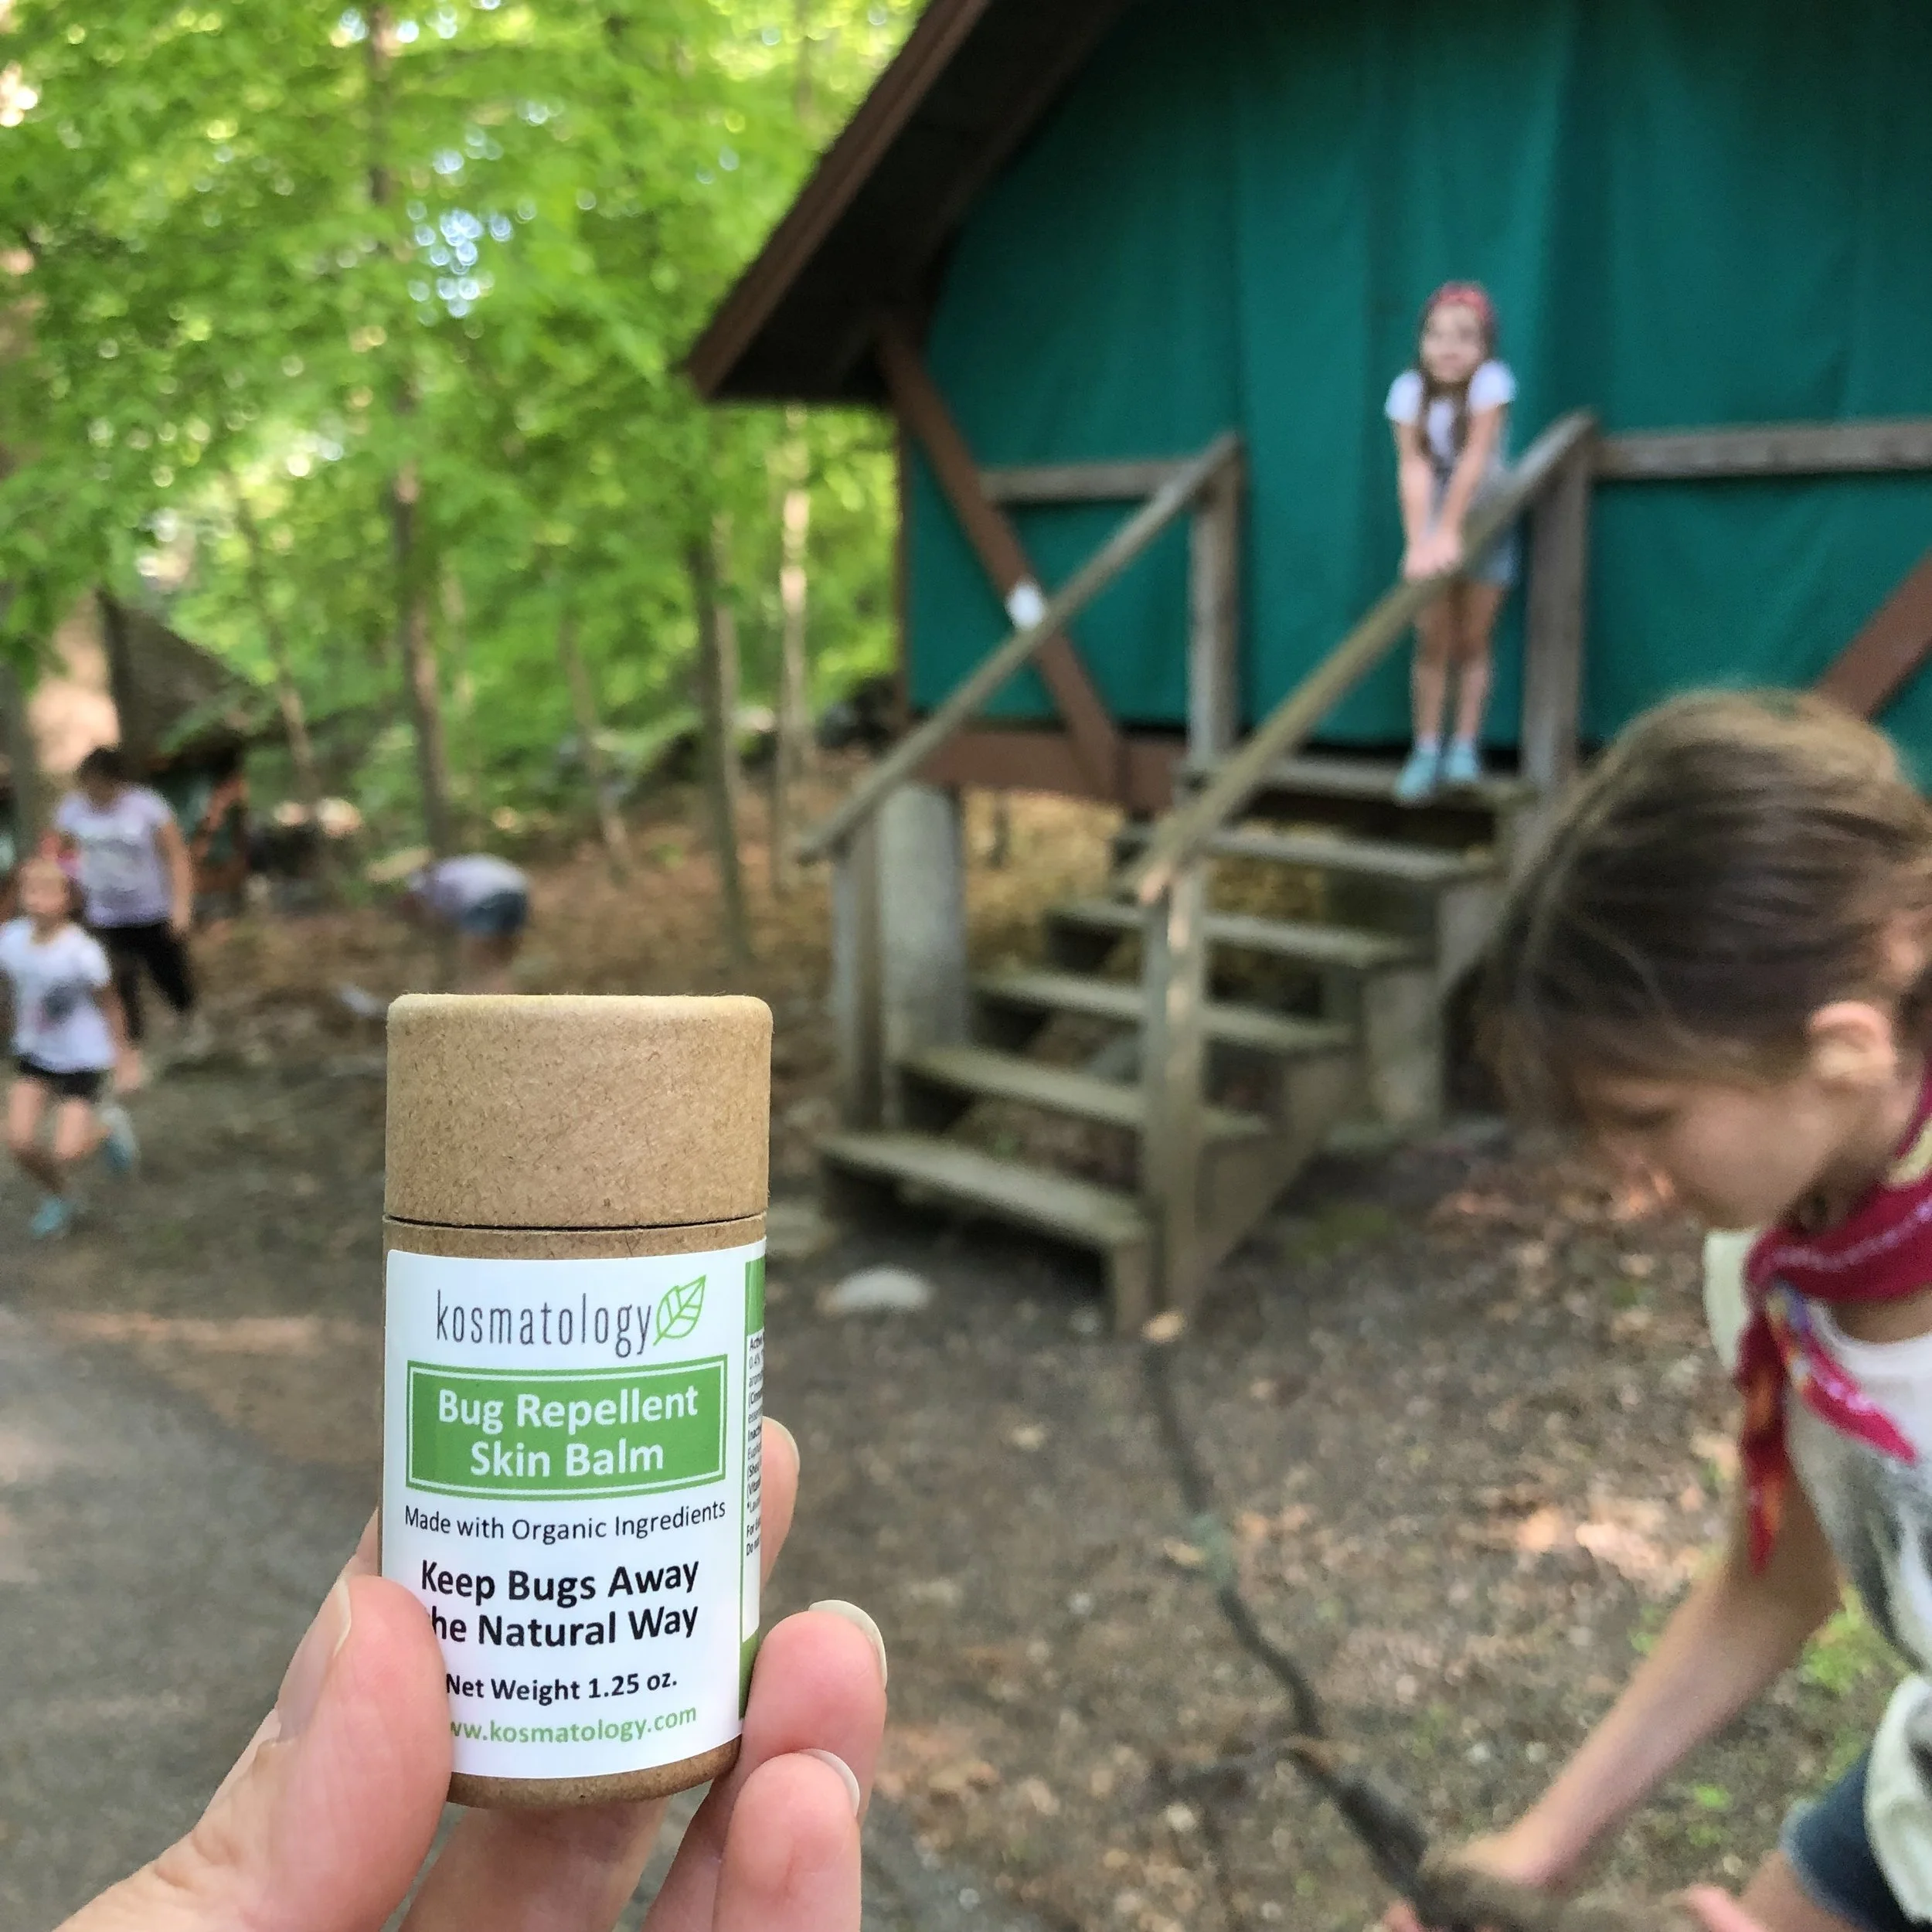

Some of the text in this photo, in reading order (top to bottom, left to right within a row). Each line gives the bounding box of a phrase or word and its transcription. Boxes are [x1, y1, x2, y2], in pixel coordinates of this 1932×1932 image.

[437, 1289, 651, 1359] kosmatology
[439, 1389, 505, 1435] Bug
[516, 1385, 699, 1435] Repellent
[471, 1438, 665, 1478] Skin Balm
[405, 1505, 451, 1534] Made
[456, 1516, 505, 1539] with
[512, 1518, 607, 1546] Organic
[615, 1501, 726, 1539] Ingredients
[421, 1560, 699, 1610] Keep Bugs Away
[426, 1605, 699, 1648] he Natural Way
[446, 1672, 678, 1706] Net Weight 1.25 oz.
[450, 1707, 696, 1743] ww.kosmatology.com
